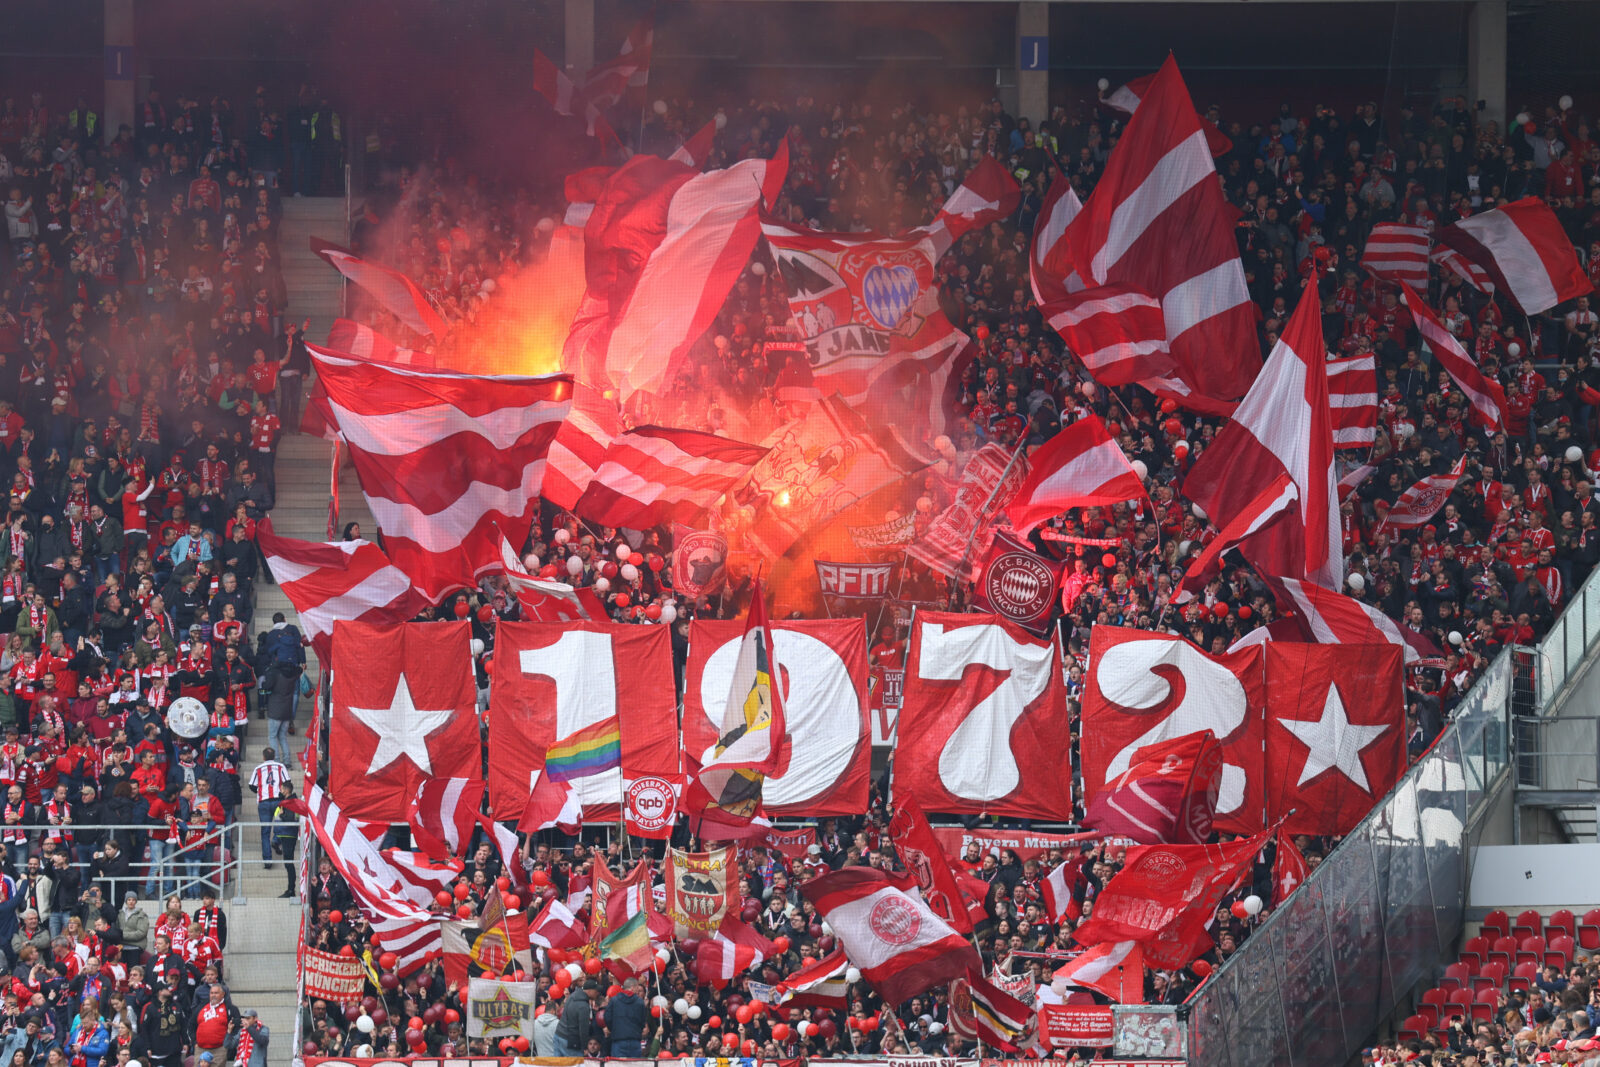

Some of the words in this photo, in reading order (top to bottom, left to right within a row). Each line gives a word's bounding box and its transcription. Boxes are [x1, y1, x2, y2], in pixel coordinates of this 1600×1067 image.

[1030, 42, 1039, 68] J
[817, 564, 891, 595] RFM
[1016, 558, 1049, 588] BAYERN
[991, 578, 1026, 615] MÜNCHEN
[266, 770, 275, 786] 4
[631, 780, 672, 800] QUEERPASS
[638, 796, 663, 810] qpb
[634, 813, 665, 827] BAYERN
[766, 833, 807, 847] ayern
[962, 834, 1019, 850] Bayern
[1024, 837, 1098, 849] München
[672, 855, 726, 872] ULTRA
[305, 953, 366, 976] SCHICKERI
[305, 969, 366, 993] MÜNCHEN
[478, 1002, 525, 1018] ULTRAS
